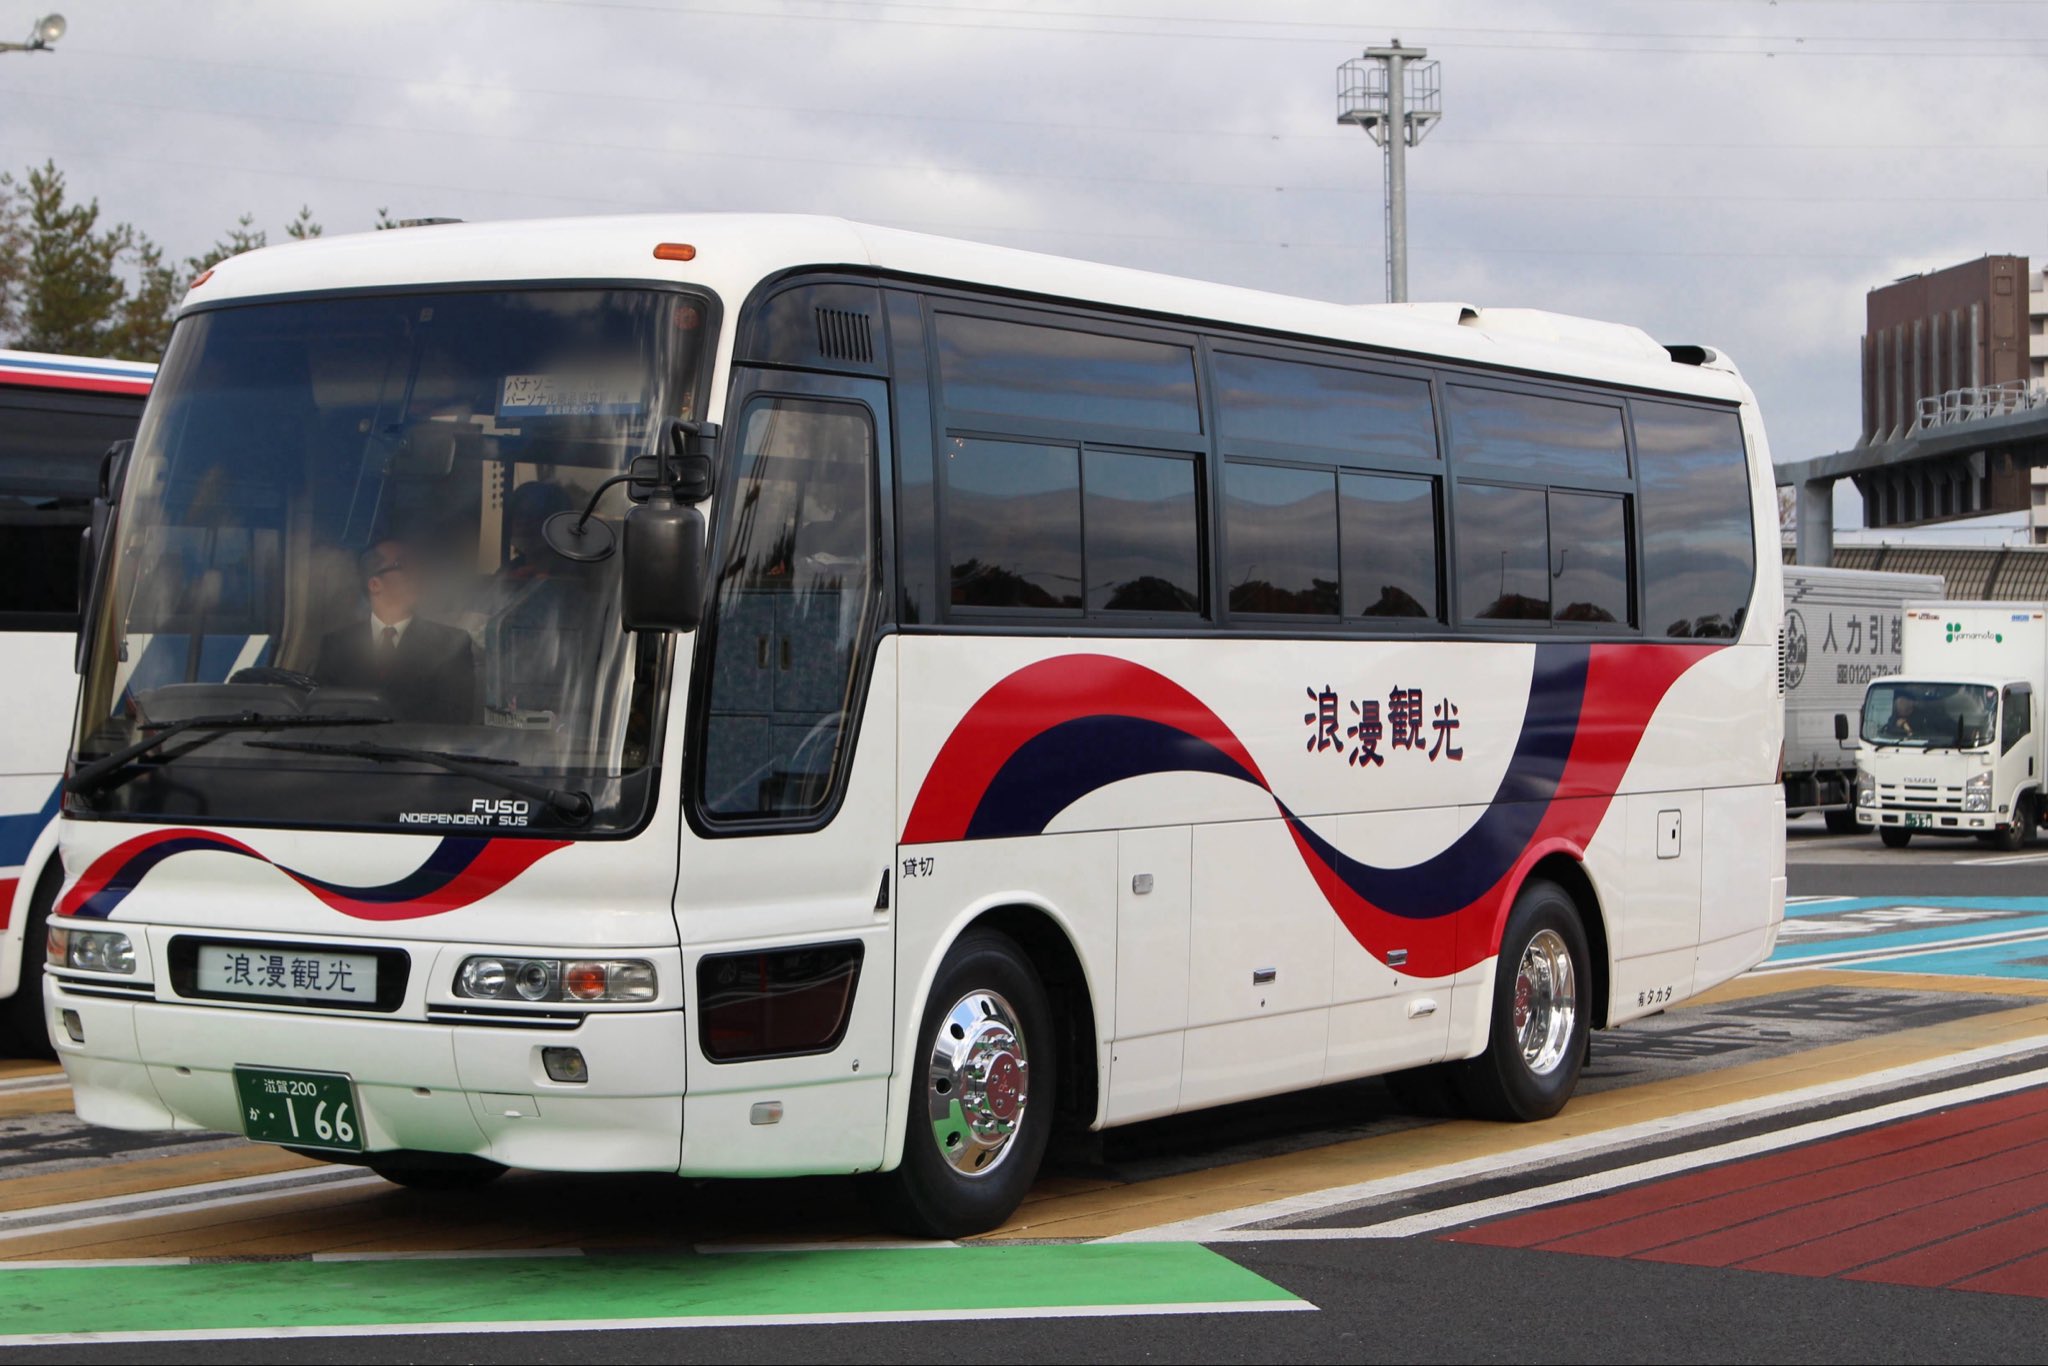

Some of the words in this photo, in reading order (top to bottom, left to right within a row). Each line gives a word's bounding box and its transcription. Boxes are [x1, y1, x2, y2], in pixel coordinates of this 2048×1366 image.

[1953, 630, 1995, 642] yamamoto
[1304, 684, 1463, 768] 浪漫観光
[471, 798, 529, 815] FUSO
[399, 812, 493, 825] INDEPENDENT
[498, 815, 528, 826] SUS
[902, 856, 934, 879] 貸切
[224, 953, 356, 993] 浪漫観光
